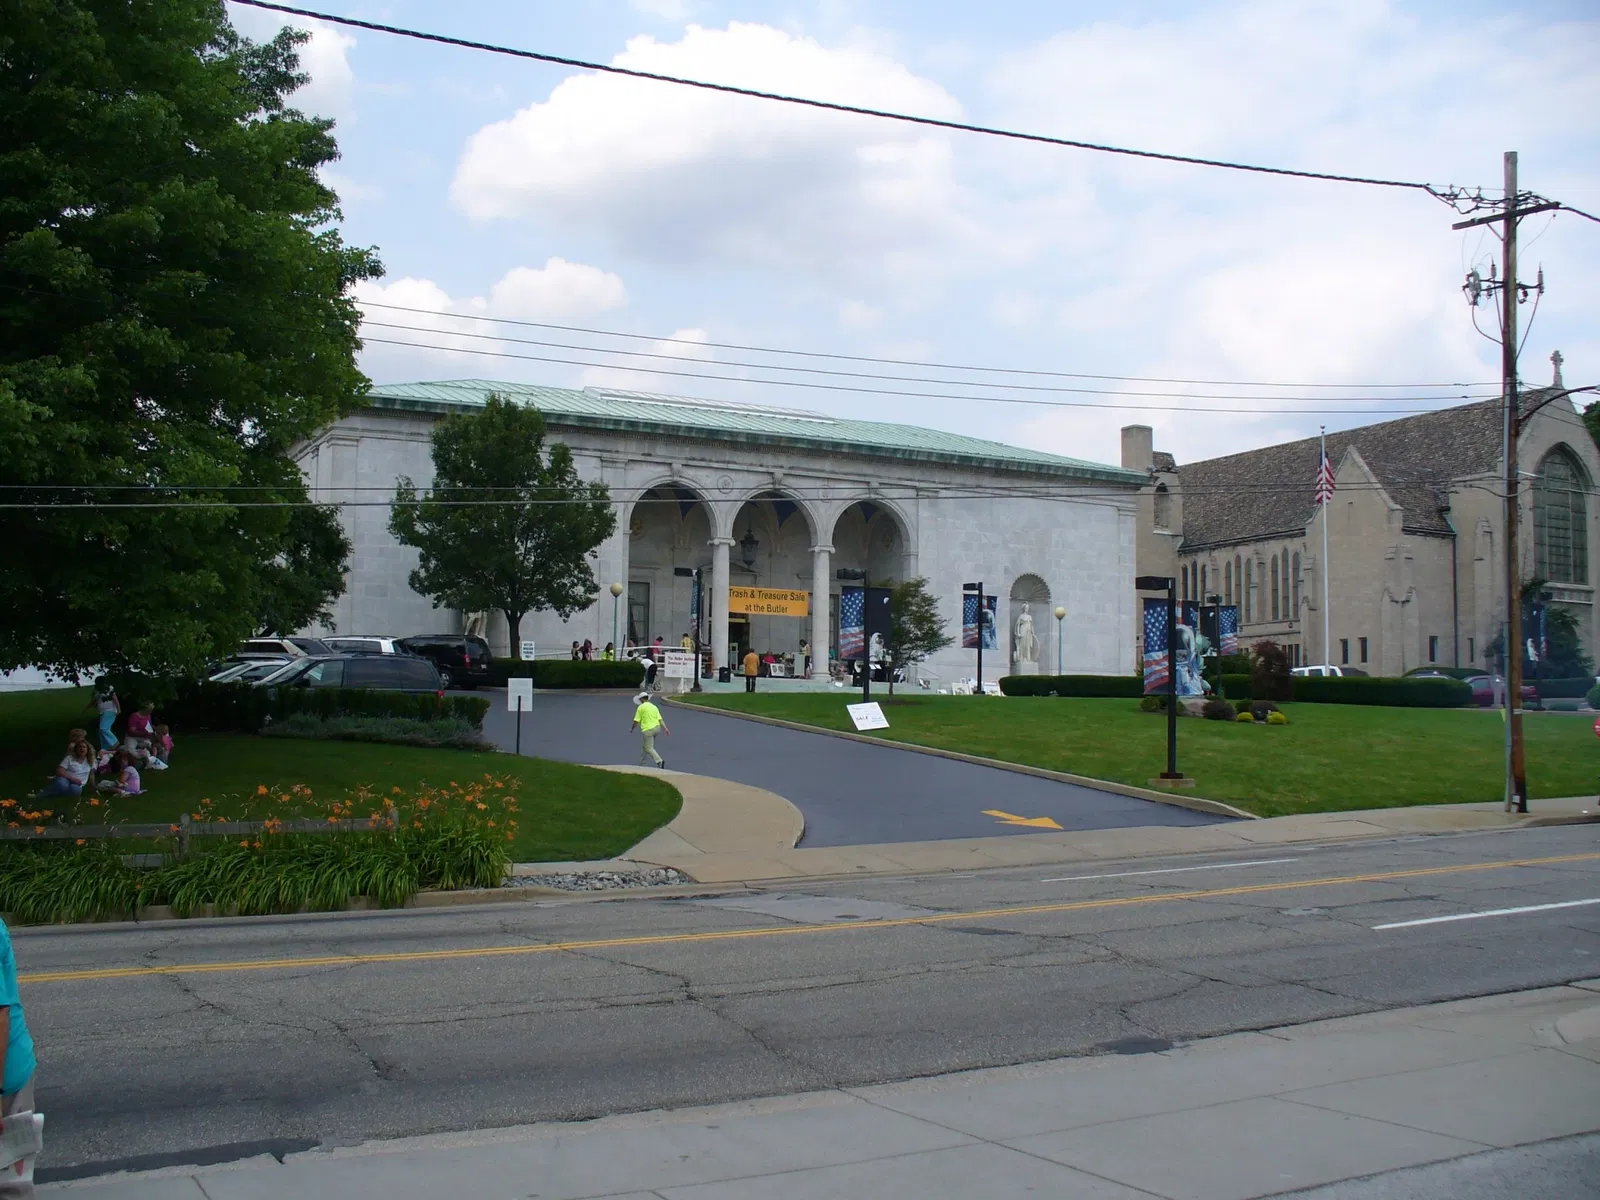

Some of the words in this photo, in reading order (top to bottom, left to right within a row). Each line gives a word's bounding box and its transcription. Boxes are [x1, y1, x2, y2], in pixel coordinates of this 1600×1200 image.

[729, 588, 748, 599] Trash
[750, 590, 755, 599] &
[757, 590, 788, 601] Treasure
[790, 592, 806, 602] Sale
[745, 604, 752, 612] at
[754, 604, 765, 612] the
[766, 604, 789, 614] Butler
